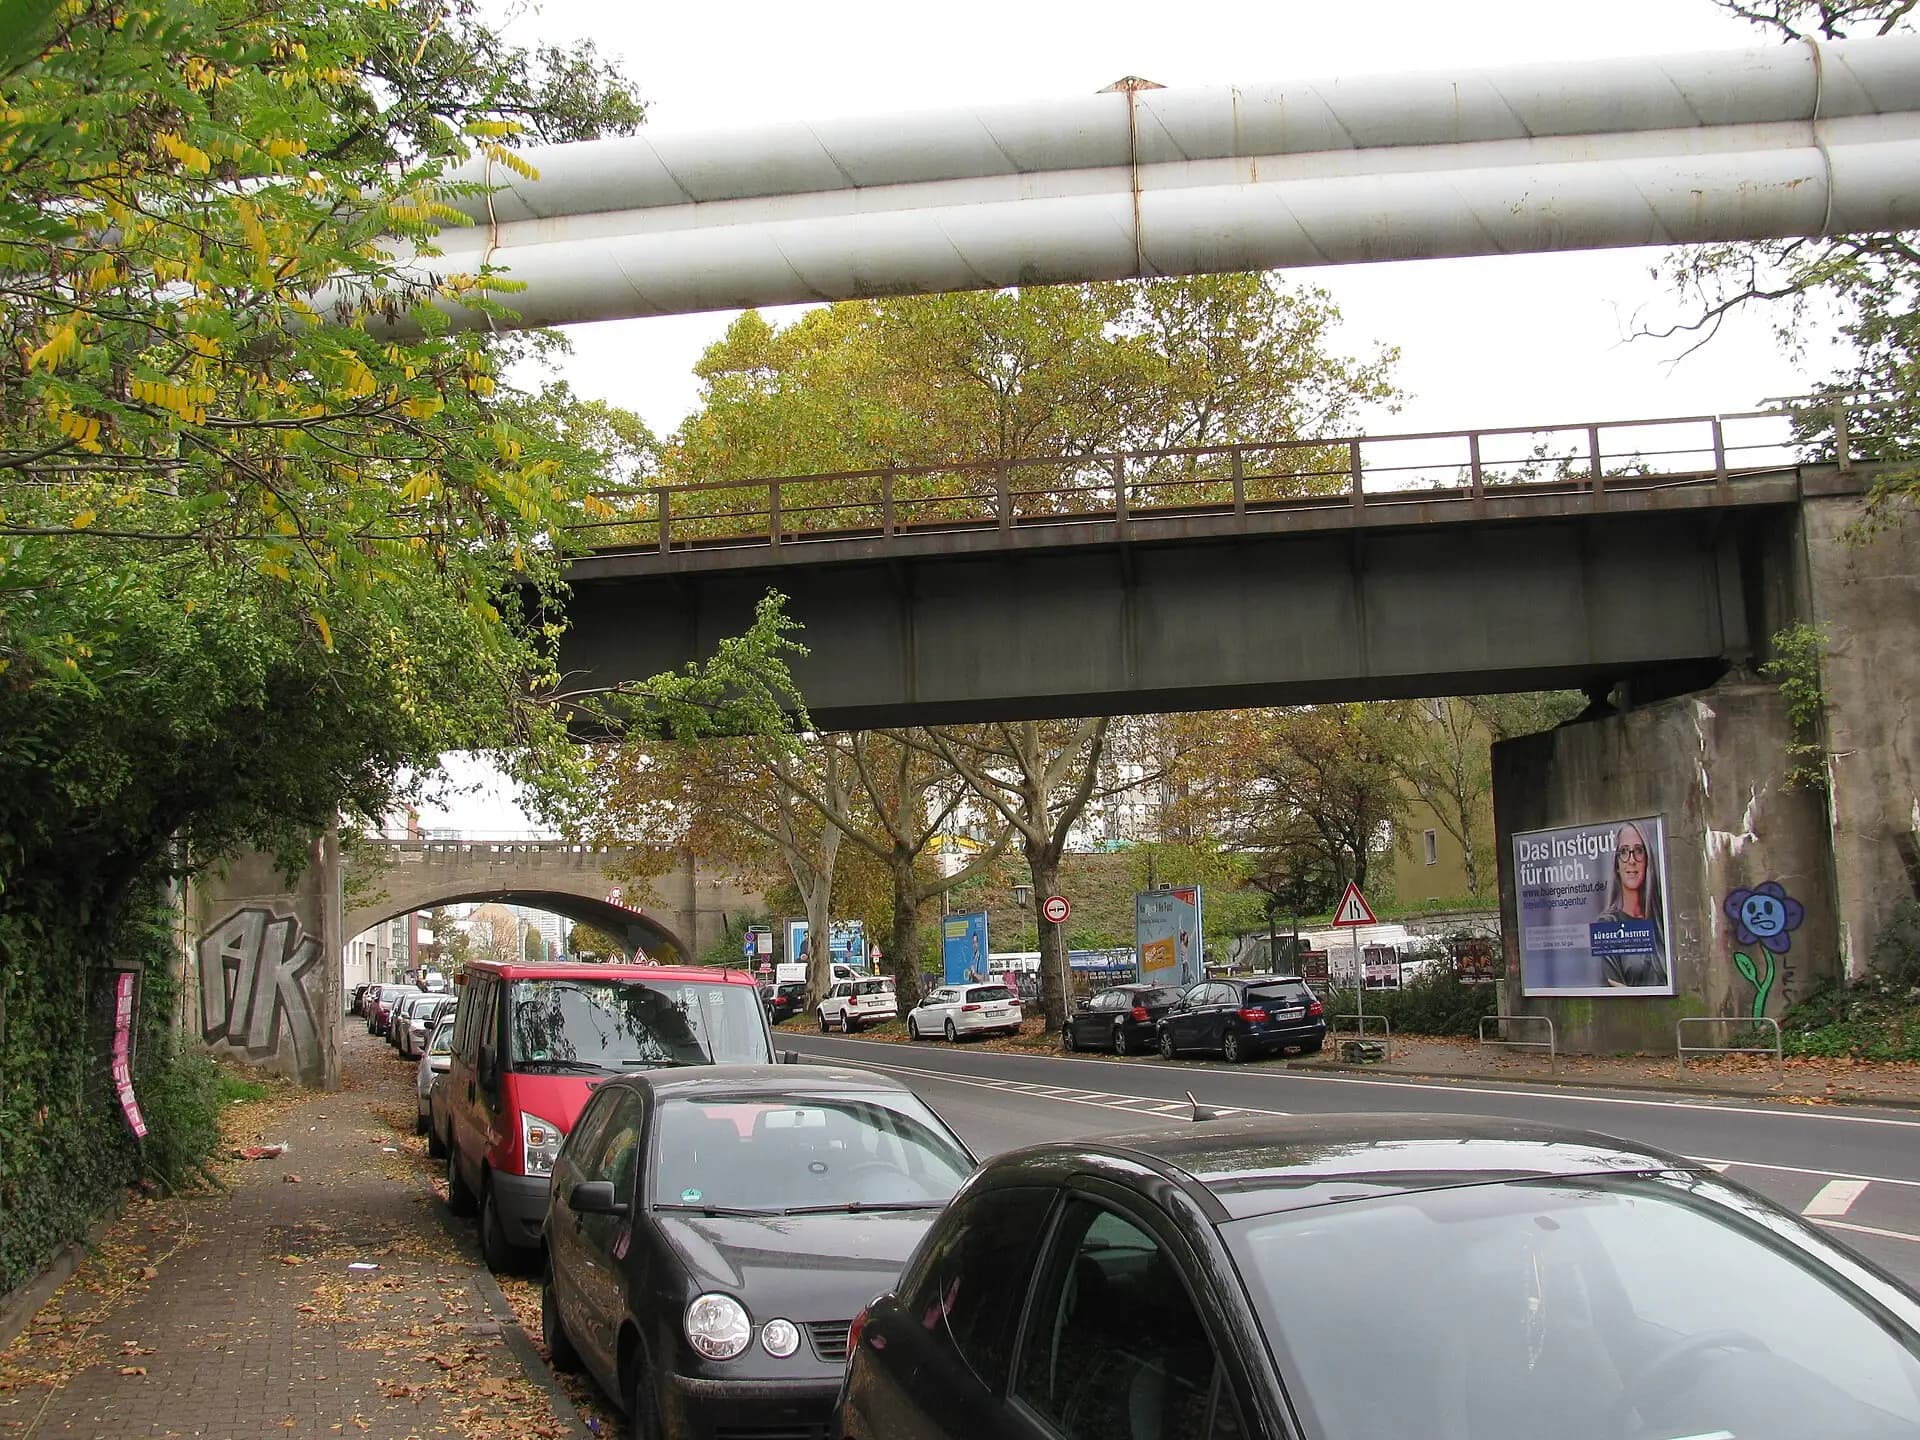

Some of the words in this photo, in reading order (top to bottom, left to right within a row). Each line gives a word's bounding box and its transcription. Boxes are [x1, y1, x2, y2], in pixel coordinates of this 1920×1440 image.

[1520, 840, 1549, 861] Das
[1552, 830, 1616, 860] Instigut
[1520, 863, 1542, 885] für
[1545, 858, 1589, 883] mich.
[198, 908, 325, 1083] AK
